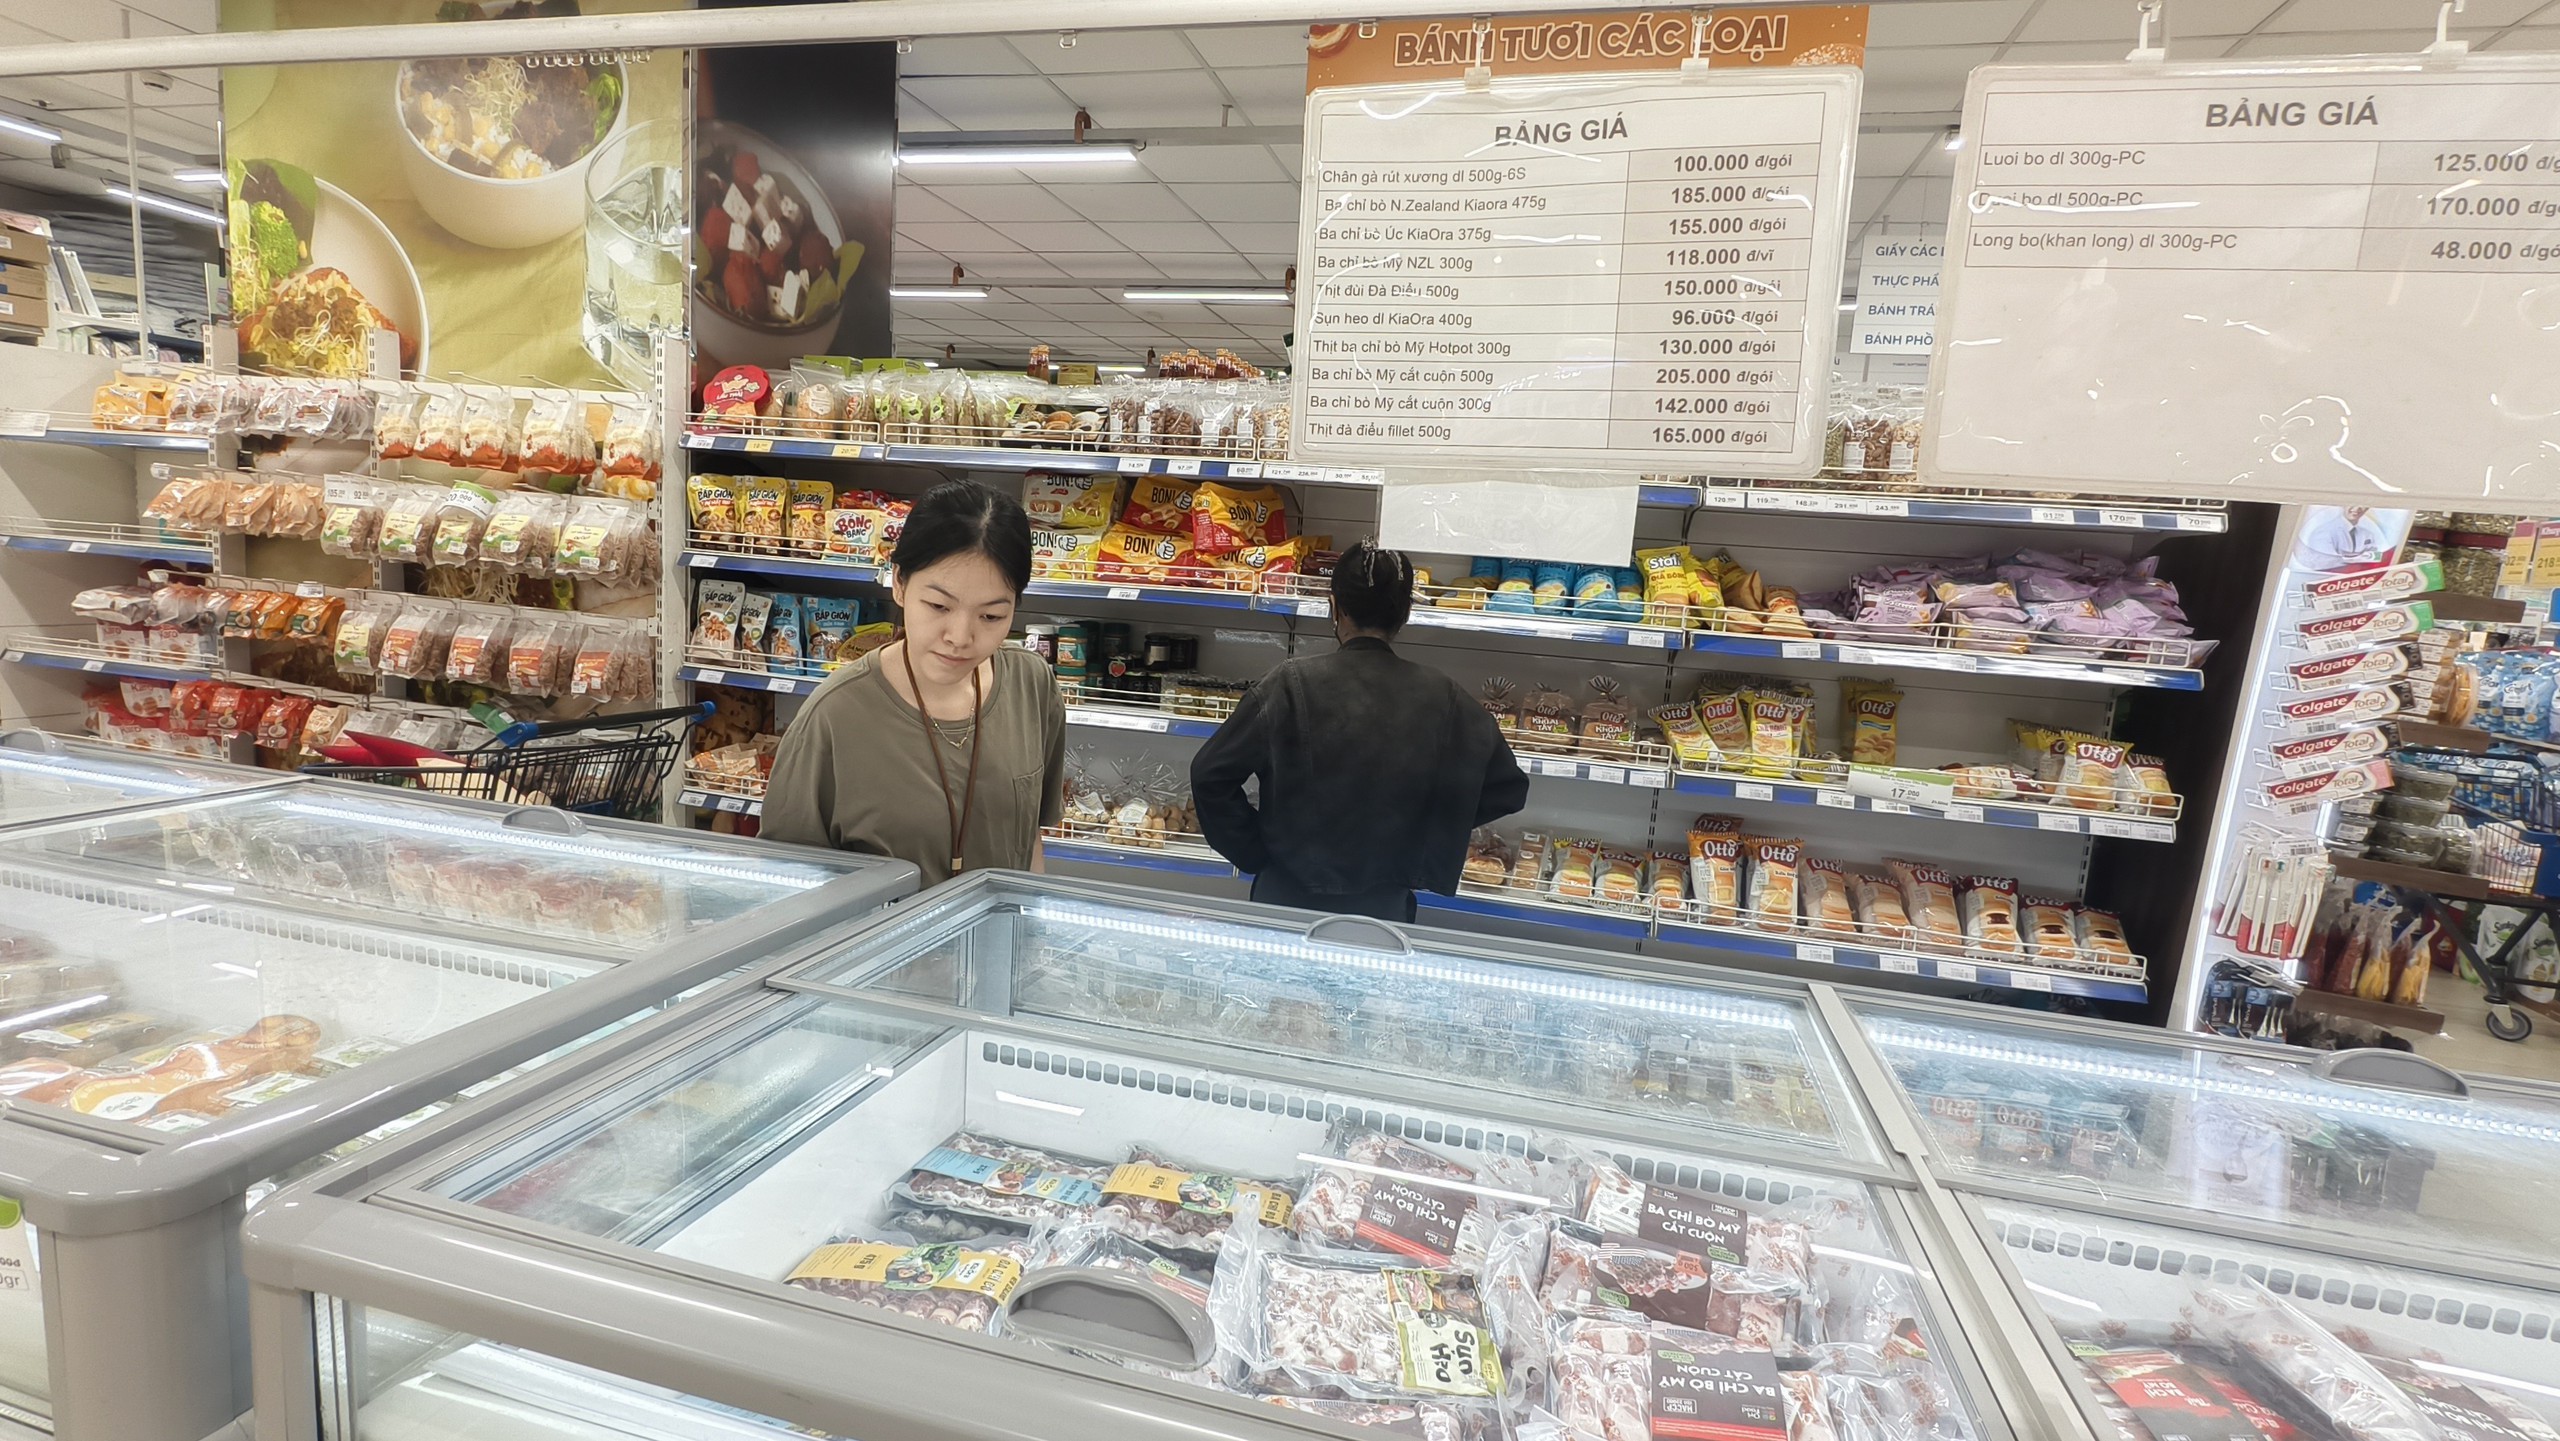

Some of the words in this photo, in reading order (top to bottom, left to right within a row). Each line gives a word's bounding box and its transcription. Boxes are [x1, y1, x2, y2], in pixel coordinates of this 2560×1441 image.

[1395, 23, 1493, 66] BÁNH
[1501, 21, 1591, 61] TƯƠI
[1599, 13, 1685, 57] CÁC
[2206, 98, 2306, 128] BẢNG
[2318, 95, 2378, 126] GIÁ
[1495, 119, 1571, 146] BẢNG
[1580, 112, 1628, 140] GIÁ
[1674, 154, 1749, 172] 100.000
[1755, 154, 1792, 170] đ/gói
[1983, 152, 2017, 165] Luoi
[2024, 152, 2044, 165] bo
[2070, 151, 2146, 168] 300g-PC
[2434, 154, 2528, 172] 125.000
[1323, 170, 1357, 183] Chân
[1362, 170, 1378, 186] gà
[1382, 170, 1400, 183] rút
[1404, 169, 1447, 185] xương
[1469, 167, 1526, 184] 500g-6S
[1672, 186, 1745, 203] 185.000
[2024, 193, 2042, 206] bo
[2068, 192, 2142, 207] 500g-PC
[1325, 199, 1342, 211] Ba
[1347, 199, 1366, 211] chỉ
[1370, 200, 1386, 211] bò
[1391, 199, 1459, 211] N.Zealand
[1464, 199, 1507, 211] Kiaora
[1512, 196, 1546, 209] 475g
[2426, 197, 2520, 216] 170.000
[2527, 200, 2560, 217] đ/g
[1319, 228, 1337, 239] Ba
[1341, 227, 1360, 239] chỉ
[1385, 225, 1402, 240] Úc
[1407, 228, 1453, 240] KiaOra
[1458, 228, 1491, 242] 375g
[1669, 217, 1743, 235] 155.000
[1749, 218, 1786, 232] đ/gói
[1876, 242, 1906, 256] GIẤY
[1910, 244, 1937, 256] CÁC
[1973, 233, 2013, 248] Long
[2020, 233, 2087, 249] bo(khan
[2092, 233, 2134, 251] long)
[2160, 234, 2237, 251] 300g-PC
[2431, 241, 2511, 260] 48.000
[1318, 257, 1335, 268] Ba
[1340, 256, 1359, 268] chỉ
[1383, 256, 1402, 271] Mỹ
[1407, 257, 1434, 268] NZL
[1440, 257, 1472, 271] 300g
[1667, 249, 1740, 265] 118.000
[1665, 279, 1737, 295] 150.000
[1873, 275, 1909, 288] THỰC
[1317, 284, 1341, 298] Thịt
[1345, 284, 1364, 297] đùi
[1368, 284, 1386, 297] Đà
[1426, 285, 1458, 299] 500g
[1672, 310, 1735, 325] 96.000
[1742, 311, 1778, 324] đ/gói
[1868, 303, 1906, 315] BÁNH
[1910, 304, 1934, 315] TRÁ
[1314, 313, 1340, 327] Sụn
[1345, 313, 1368, 324] heo
[1389, 313, 1434, 325] KiaOra
[1439, 314, 1472, 328] 400g
[1660, 339, 1732, 354] 130.000
[1739, 341, 1775, 354] đ/gói
[1865, 332, 1901, 344] BÁNH
[1313, 340, 1337, 353] Thịt
[1341, 341, 1356, 352] ba
[1361, 340, 1380, 352] chỉ
[1384, 341, 1400, 352] bò
[1405, 341, 1424, 355] Mỹ
[1429, 342, 1473, 356] Hotpot
[1477, 343, 1510, 356] 300g
[1312, 369, 1329, 379] Ba
[1333, 368, 1352, 380] chỉ
[1356, 369, 1372, 380] bò
[1376, 369, 1395, 382] Mỹ
[1400, 369, 1419, 381] cắt
[1424, 372, 1455, 384] cuộn
[1460, 371, 1493, 384] 500g
[1656, 369, 1730, 384] 205.000
[1737, 371, 1773, 385] đ/gói
[1310, 396, 1327, 407] Ba
[1331, 396, 1350, 408] chỉ
[1354, 397, 1370, 408] bò
[1375, 397, 1393, 411] Mỹ
[1399, 395, 1417, 409] cắt
[1422, 399, 1453, 412] cuộn
[1458, 399, 1491, 412] 300g
[1655, 398, 1728, 413] 142.000
[1734, 401, 1770, 415] đ/gói
[1309, 423, 1333, 436] Thịt
[1337, 423, 1352, 435] đà
[1356, 422, 1383, 437] điểu
[1388, 424, 1414, 437] fillet
[1418, 426, 1451, 440] 500g
[1652, 428, 1725, 443] 165.000
[1731, 431, 1767, 445] đ/gói
[1124, 536, 1154, 555] BON!
[2317, 576, 2375, 593] Colgate
[2382, 576, 2408, 587] Total
[2311, 617, 2366, 633] Colgate
[2373, 616, 2400, 627] Total
[2301, 658, 2356, 675] Colgate
[2362, 657, 2389, 668] Total
[1707, 701, 1733, 718] Otto
[1757, 703, 1785, 719] Otto
[1862, 701, 1894, 715] Otto
[2292, 697, 2347, 714] Colgate
[2353, 697, 2379, 707] Total
[2284, 739, 2338, 755] Colgate
[2344, 738, 2369, 748] Total
[2275, 778, 2327, 795] Colgate
[2333, 776, 2358, 787] Total
[1705, 840, 1736, 857] Otto
[1761, 845, 1798, 862] Otto
[1396, 1198, 1414, 1213] BÒ
[1416, 1205, 1437, 1221] CHỈ
[1441, 1215, 1456, 1229] BA
[1648, 1203, 1664, 1216] BA
[1668, 1209, 1692, 1222] CHỈ
[1696, 1215, 1715, 1228] BÒ
[1662, 1221, 1685, 1234] CẮT
[1724, 1370, 1752, 1382] CẮT
[1689, 1379, 1714, 1392] BÒ
[1719, 1381, 1748, 1395] CHỈ
[1752, 1385, 1776, 1396] BA
[1667, 1403, 1692, 1412] HACCP
